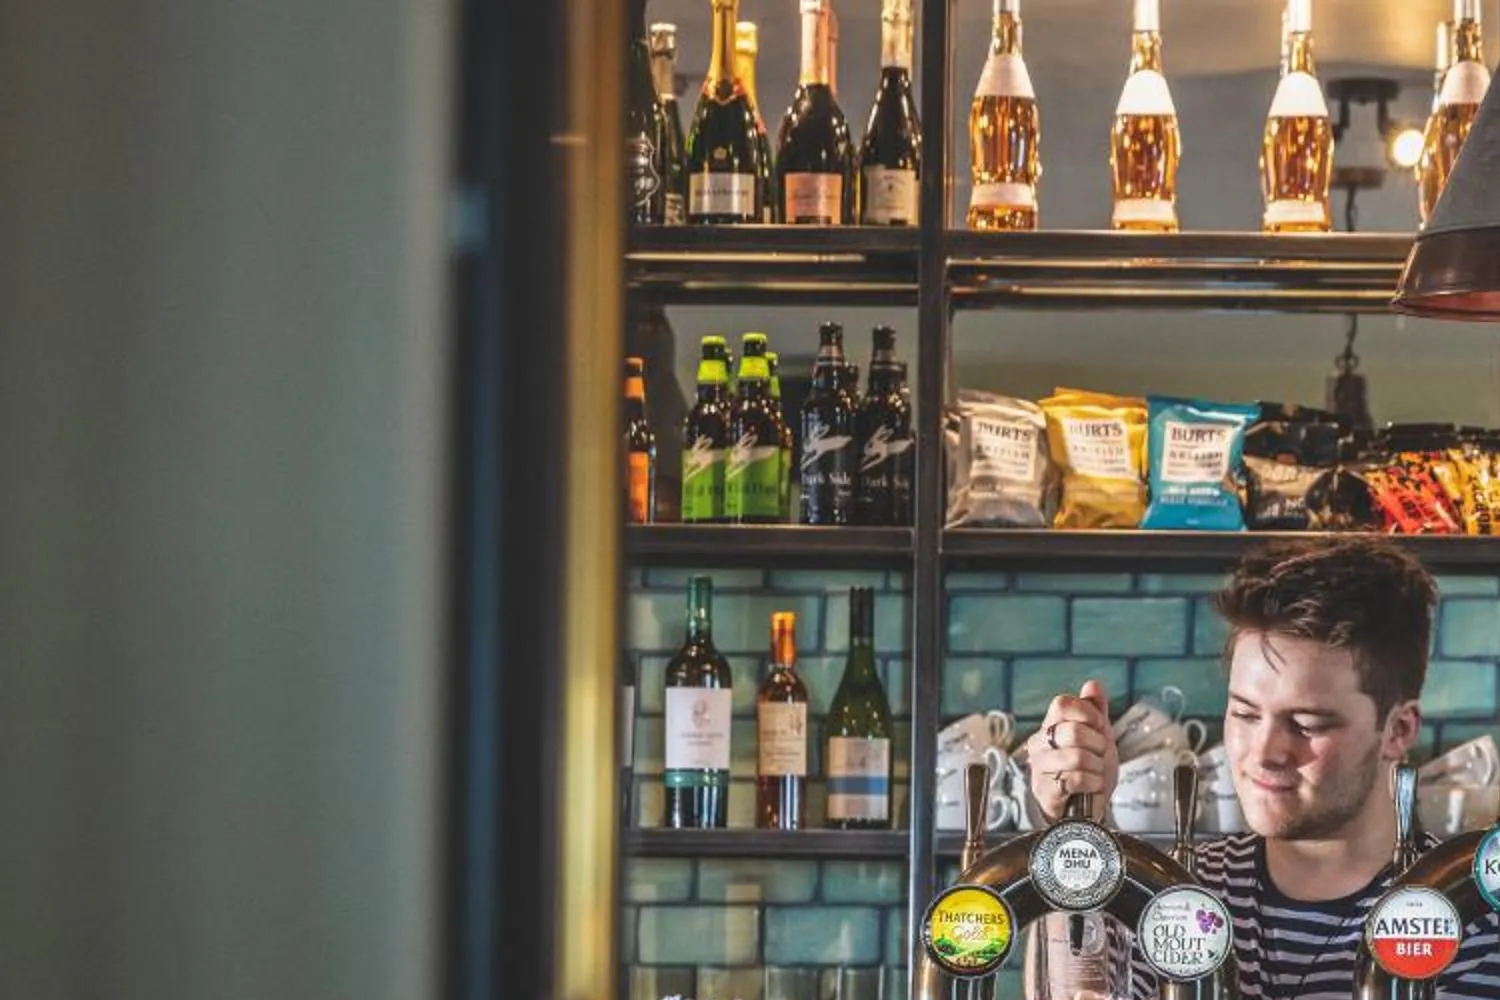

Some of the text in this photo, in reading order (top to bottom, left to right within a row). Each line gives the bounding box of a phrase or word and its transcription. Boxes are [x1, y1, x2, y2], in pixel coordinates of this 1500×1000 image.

[1171, 427, 1228, 442] BURTS
[1059, 848, 1098, 859] MENA
[1064, 859, 1091, 869] DHU
[938, 910, 1004, 925] THATCHERS
[1153, 924, 1187, 937] OLD
[1375, 918, 1455, 935] AMSTEL
[1153, 936, 1206, 951] MOUT
[1396, 942, 1433, 956] BIER
[1153, 950, 1203, 965] CIDER
